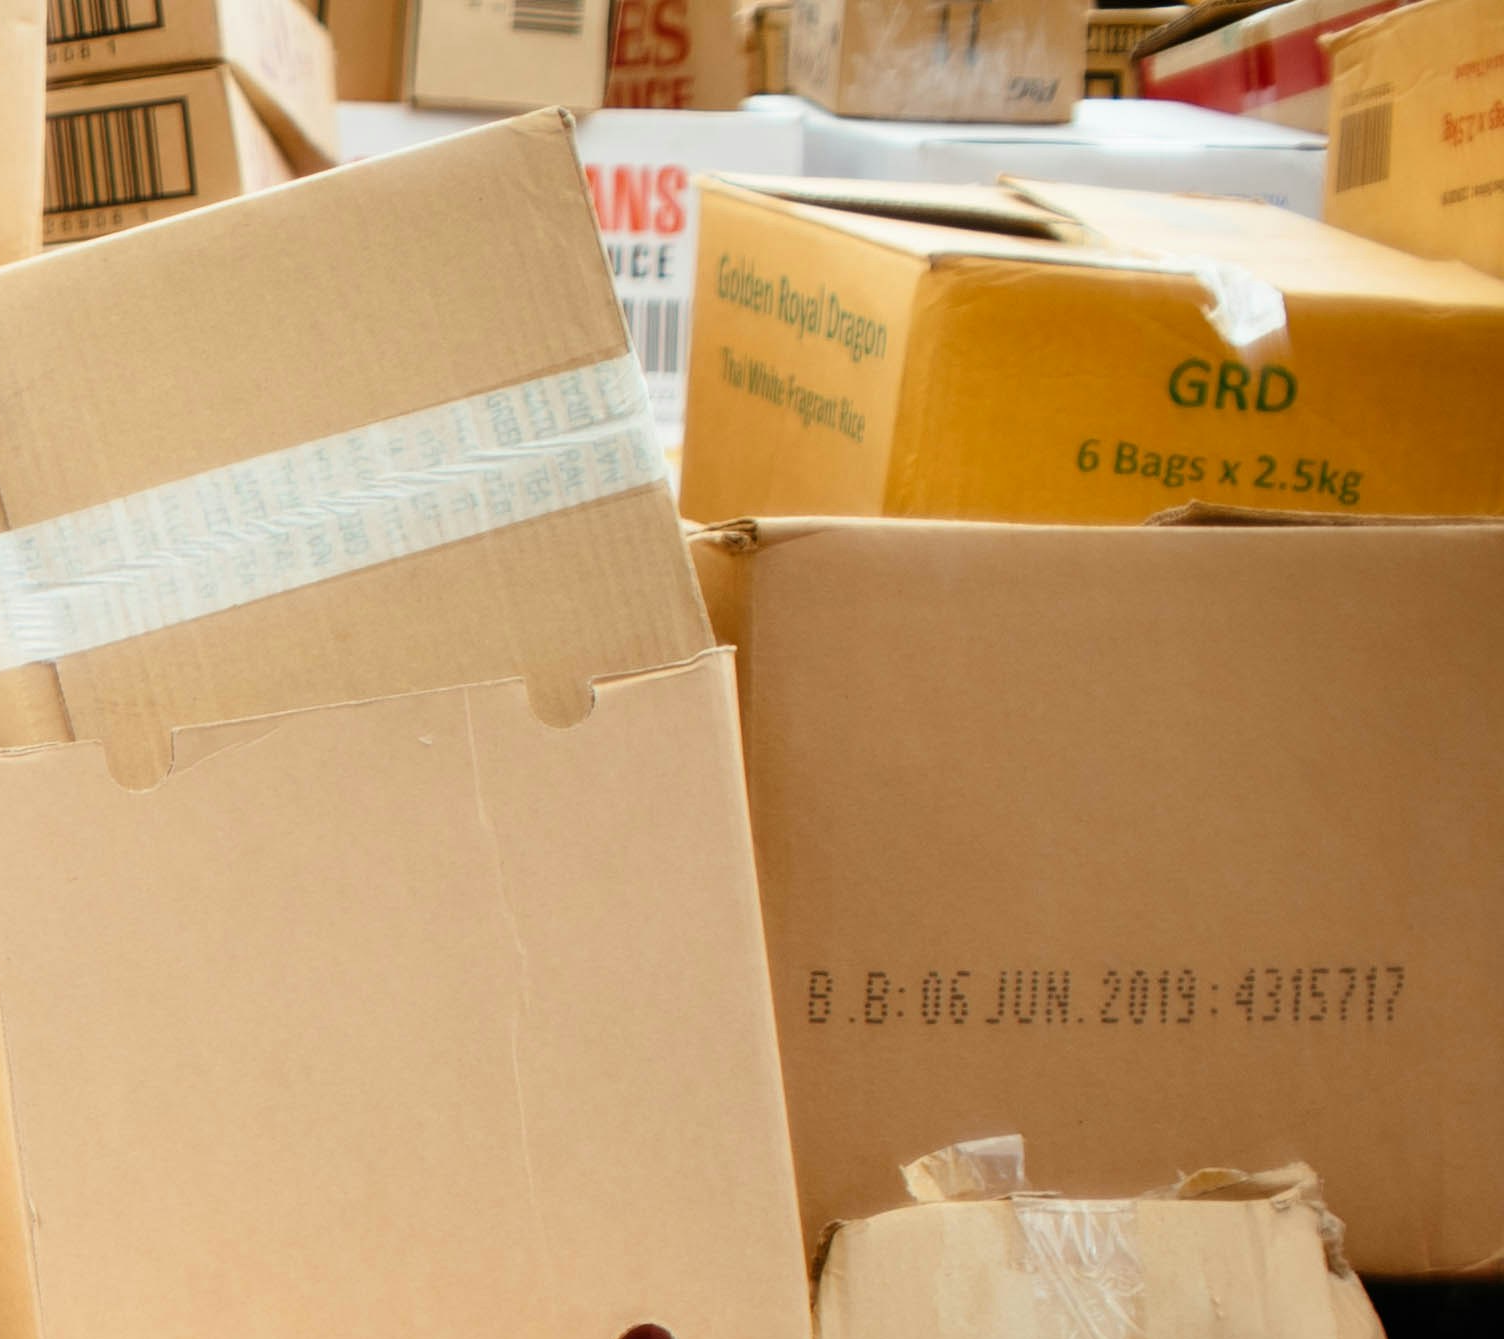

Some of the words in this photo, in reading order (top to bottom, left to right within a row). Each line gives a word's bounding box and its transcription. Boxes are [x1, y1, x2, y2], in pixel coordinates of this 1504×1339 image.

[714, 252, 776, 319] Golden
[823, 290, 888, 362] Dragon
[1167, 358, 1299, 416] GRD
[1112, 439, 1207, 489] Bags
[1250, 452, 1364, 507] 2.5kg
